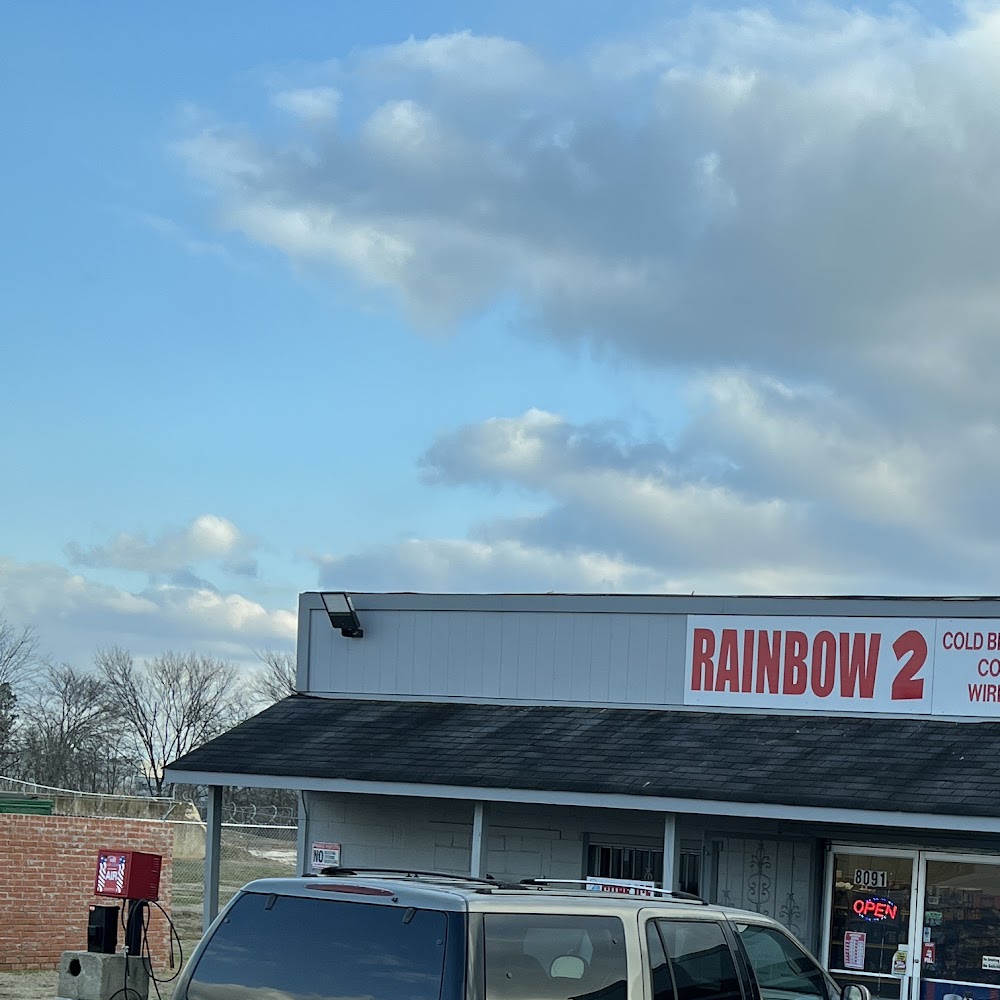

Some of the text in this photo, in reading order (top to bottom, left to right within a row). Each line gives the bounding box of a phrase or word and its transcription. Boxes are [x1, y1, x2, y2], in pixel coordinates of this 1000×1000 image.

[942, 631, 984, 650] COLD
[691, 628, 928, 700] RAINBOW 2
[313, 849, 324, 863] NO
[105, 870, 118, 881] AIR
[855, 869, 885, 887] 8091
[853, 899, 898, 920] OPEN
